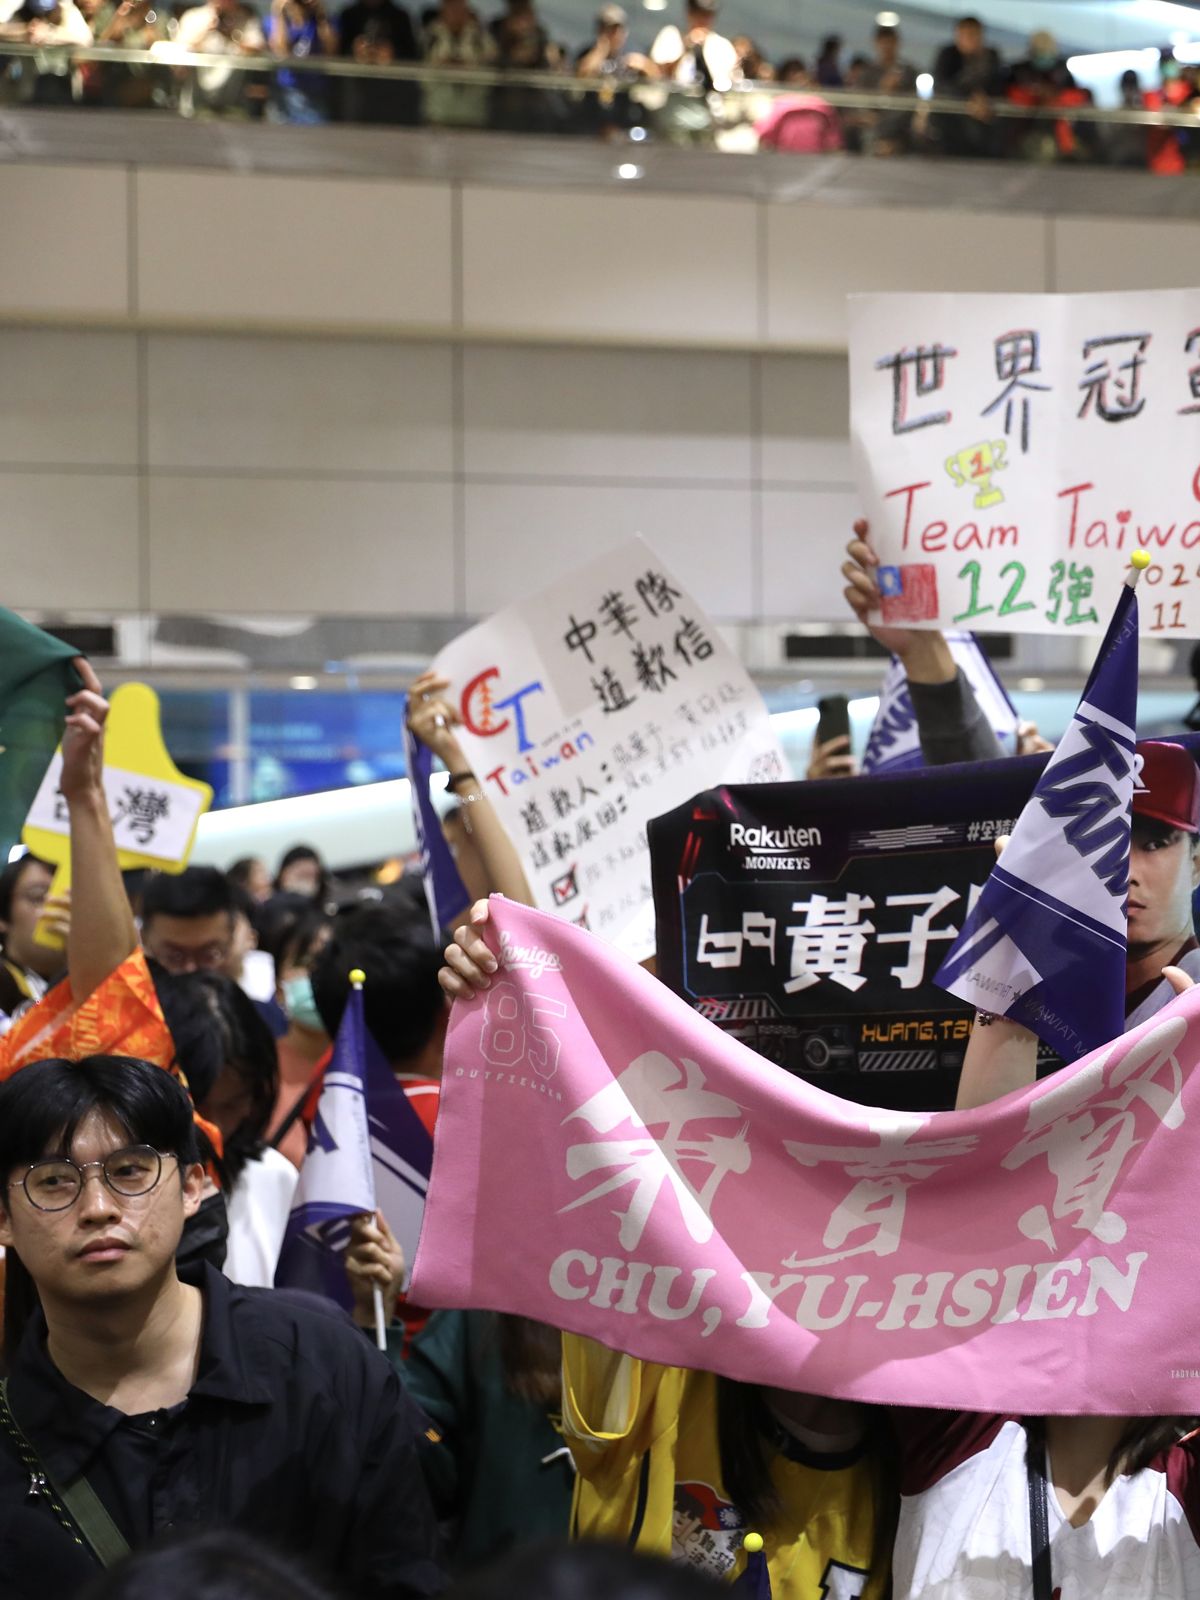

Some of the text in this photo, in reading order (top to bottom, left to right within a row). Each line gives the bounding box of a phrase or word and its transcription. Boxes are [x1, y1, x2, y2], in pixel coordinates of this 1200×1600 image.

[885, 481, 1019, 551] Team
[564, 569, 683, 663] 中華隊
[953, 559, 1100, 626] 12強
[730, 823, 822, 848] Rakuten
[744, 856, 811, 870] MONKEYS
[784, 883, 987, 994] 黃子
[479, 980, 568, 1080] 85
